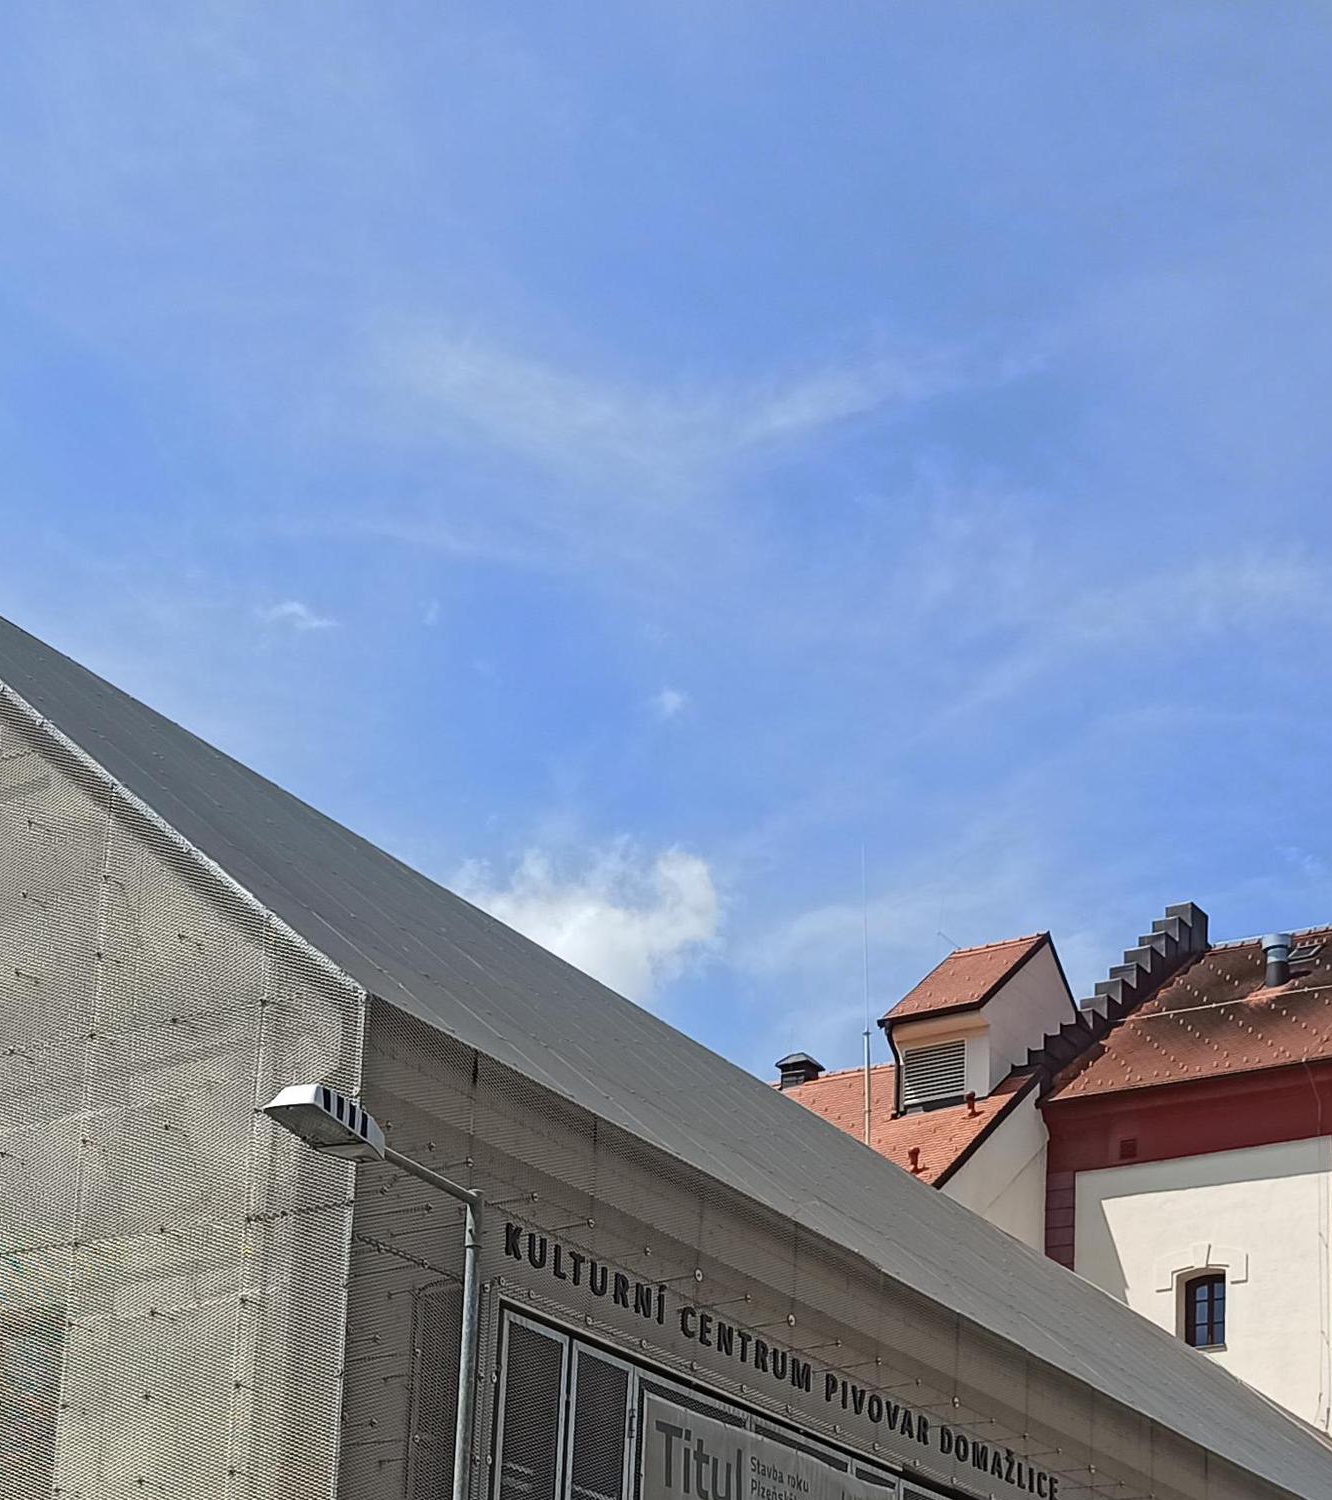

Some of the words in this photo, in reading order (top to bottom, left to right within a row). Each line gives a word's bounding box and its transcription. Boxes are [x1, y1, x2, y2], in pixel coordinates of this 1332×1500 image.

[505, 1222, 667, 1325] KULTURNÍ
[680, 1305, 813, 1393] CENTRUM
[824, 1372, 930, 1446] PIVOVAR
[750, 1455, 784, 1484] Stavba
[787, 1473, 810, 1493] roku
